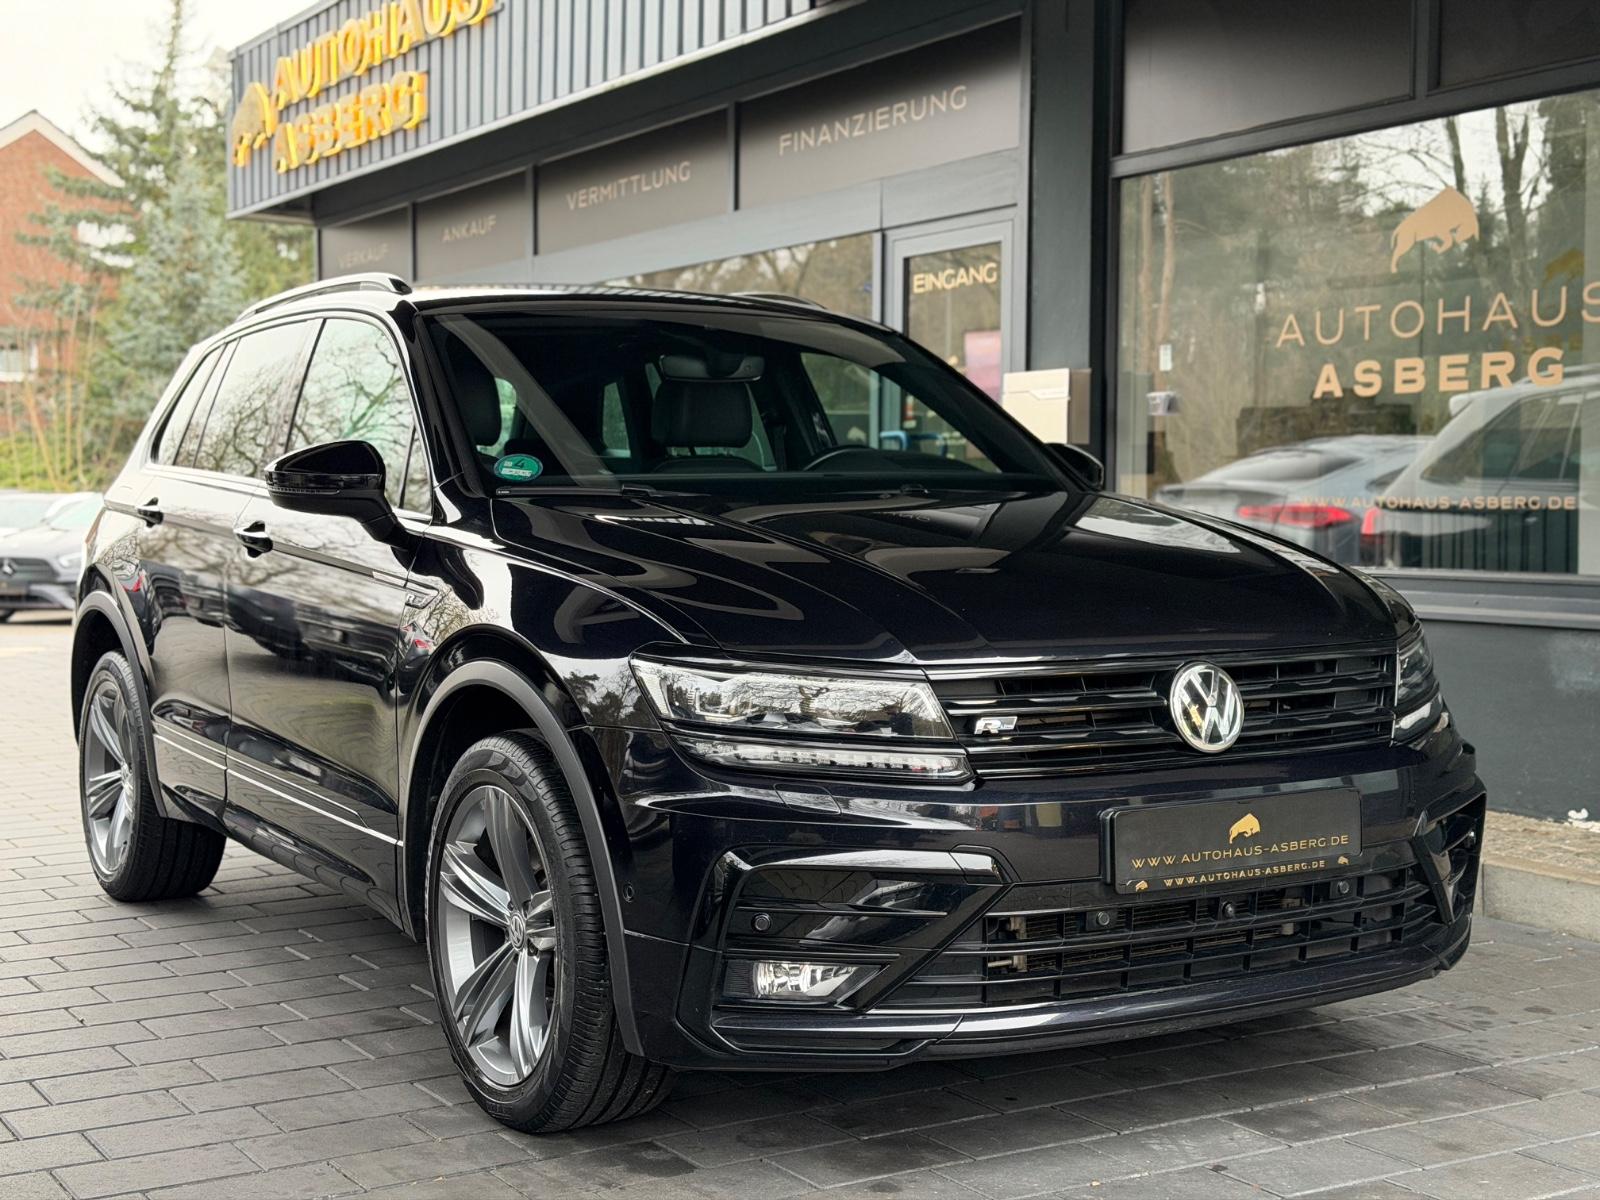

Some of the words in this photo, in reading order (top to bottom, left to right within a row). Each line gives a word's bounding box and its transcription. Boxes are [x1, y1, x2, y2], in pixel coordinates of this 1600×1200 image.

[274, 71, 428, 174] ASBERG
[778, 85, 968, 156] FINANZIERUNG
[566, 161, 691, 210] VERMITTLUNG
[441, 214, 497, 243] ANKAUF
[337, 243, 389, 269] VERKAUF
[912, 262, 998, 294] EINGANG
[1312, 347, 1564, 399] ASBERG
[1300, 495, 1577, 511] WWW.AUTOHAUS-ASBERG.DE
[1131, 834, 1350, 870] WWW.AUTOHAUS-ASBERG.DE
[1163, 860, 1326, 888] WWW.AUTOHAUS-ASBERG.DE
